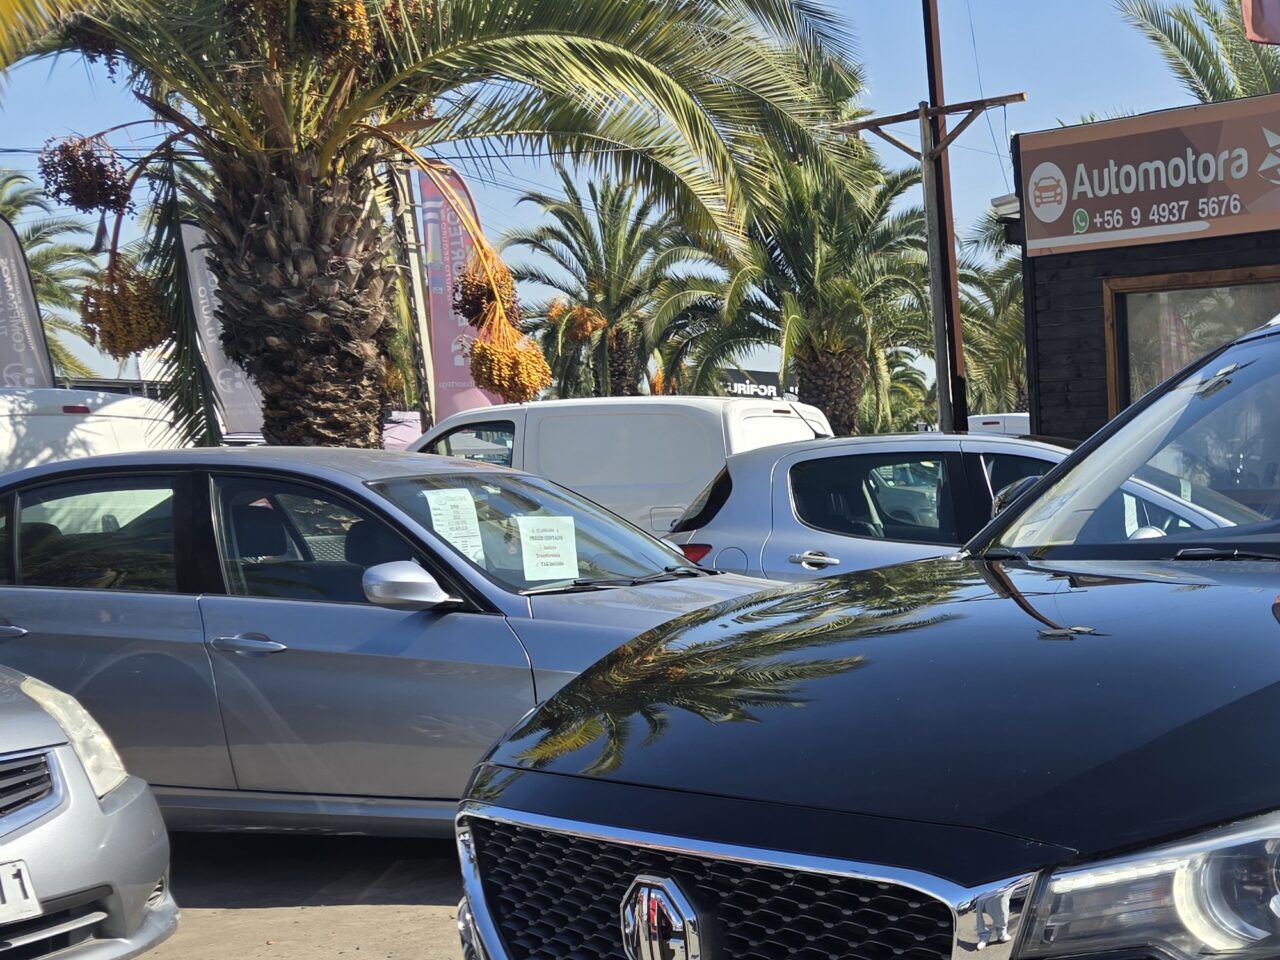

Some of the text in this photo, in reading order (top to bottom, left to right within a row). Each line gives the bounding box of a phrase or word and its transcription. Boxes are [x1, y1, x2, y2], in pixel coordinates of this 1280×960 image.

[1072, 147, 1249, 201] Automotora
[1093, 194, 1242, 230] +56 9 4937 5676
